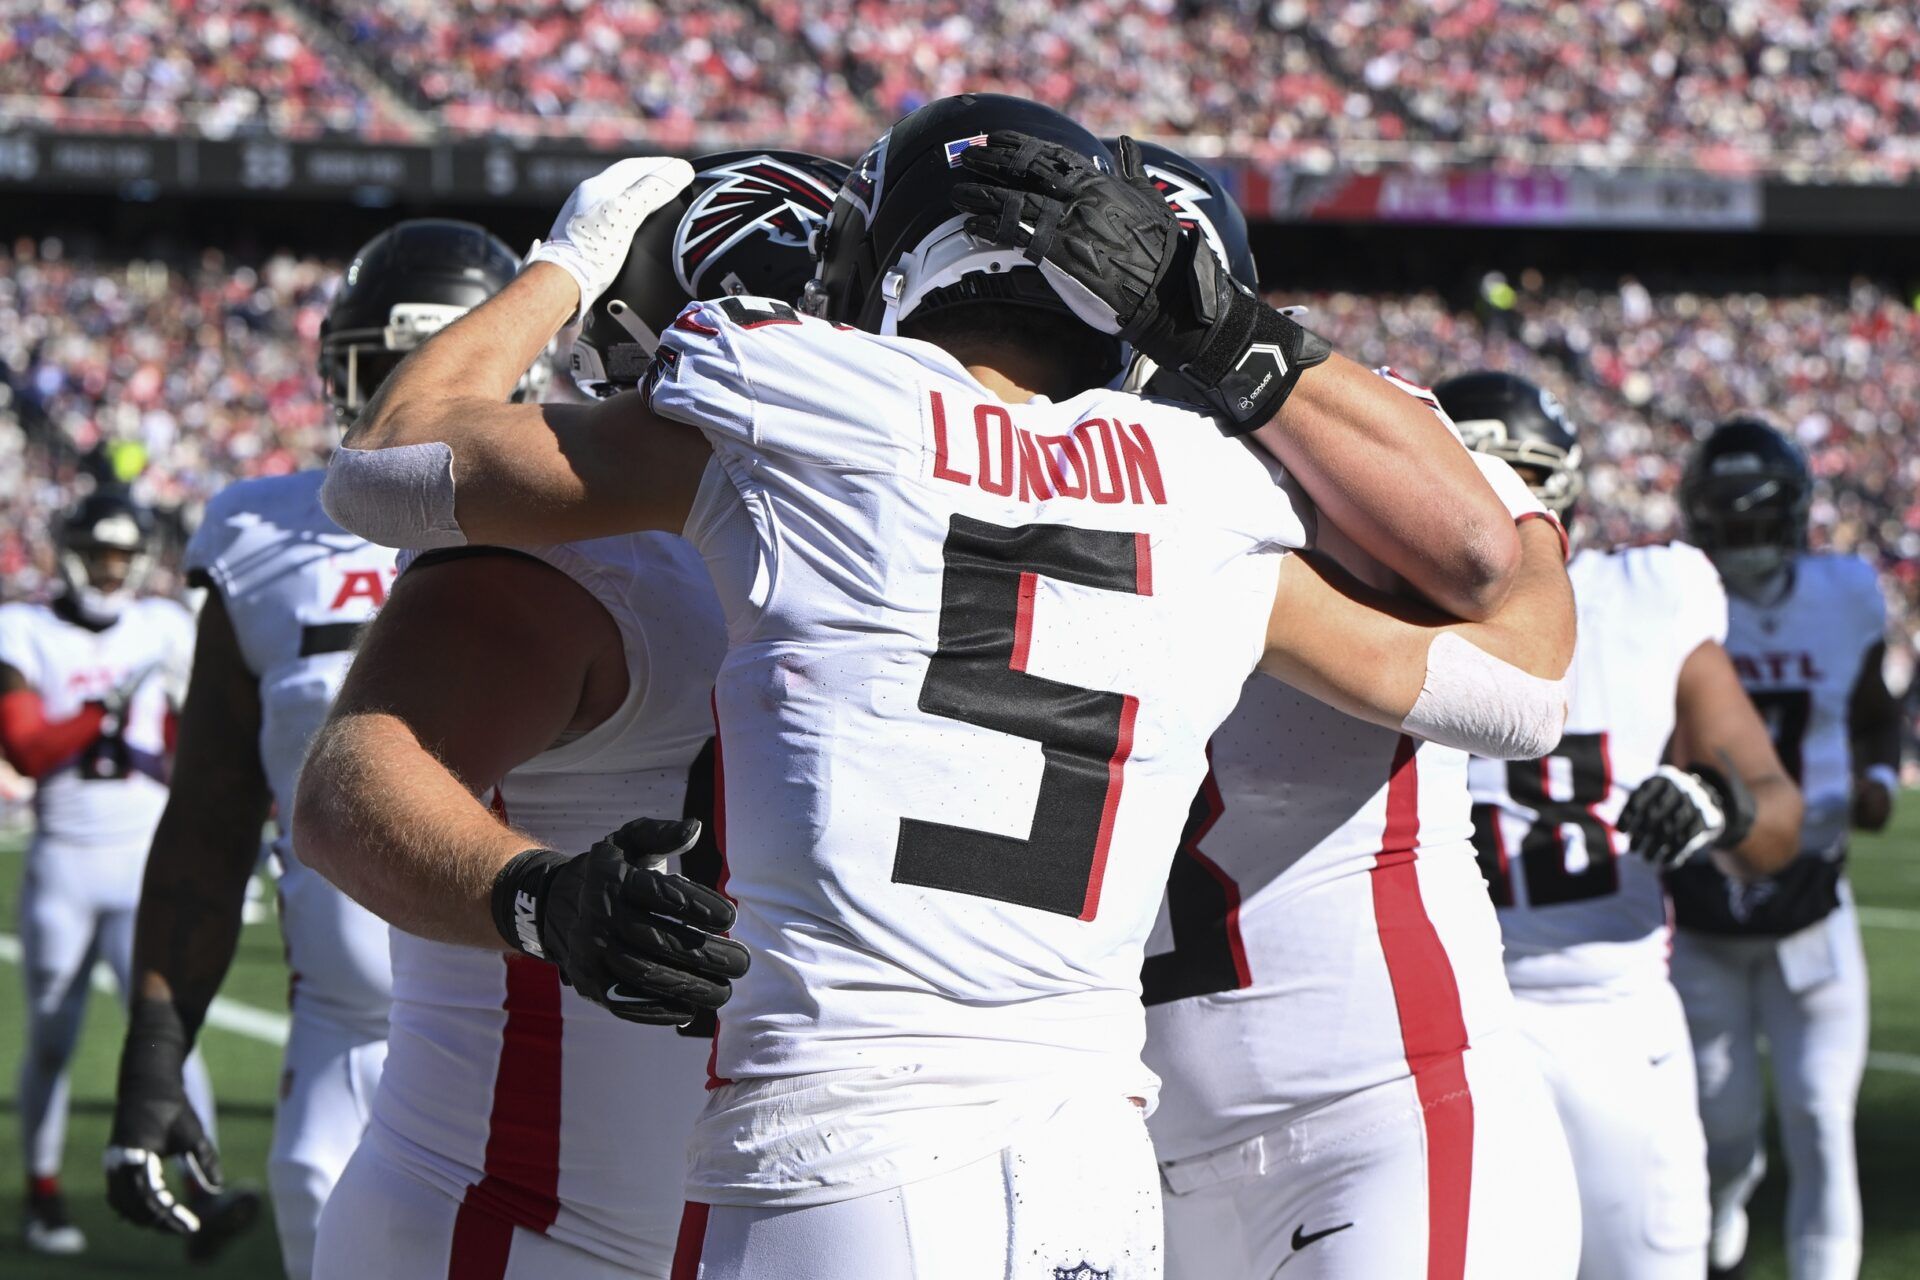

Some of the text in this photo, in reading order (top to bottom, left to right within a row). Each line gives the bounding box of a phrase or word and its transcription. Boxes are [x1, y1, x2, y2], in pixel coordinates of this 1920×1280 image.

[930, 391, 1167, 505] LONDON
[329, 569, 398, 609] A
[891, 513, 1152, 922] 5
[515, 889, 545, 959] NIKE
